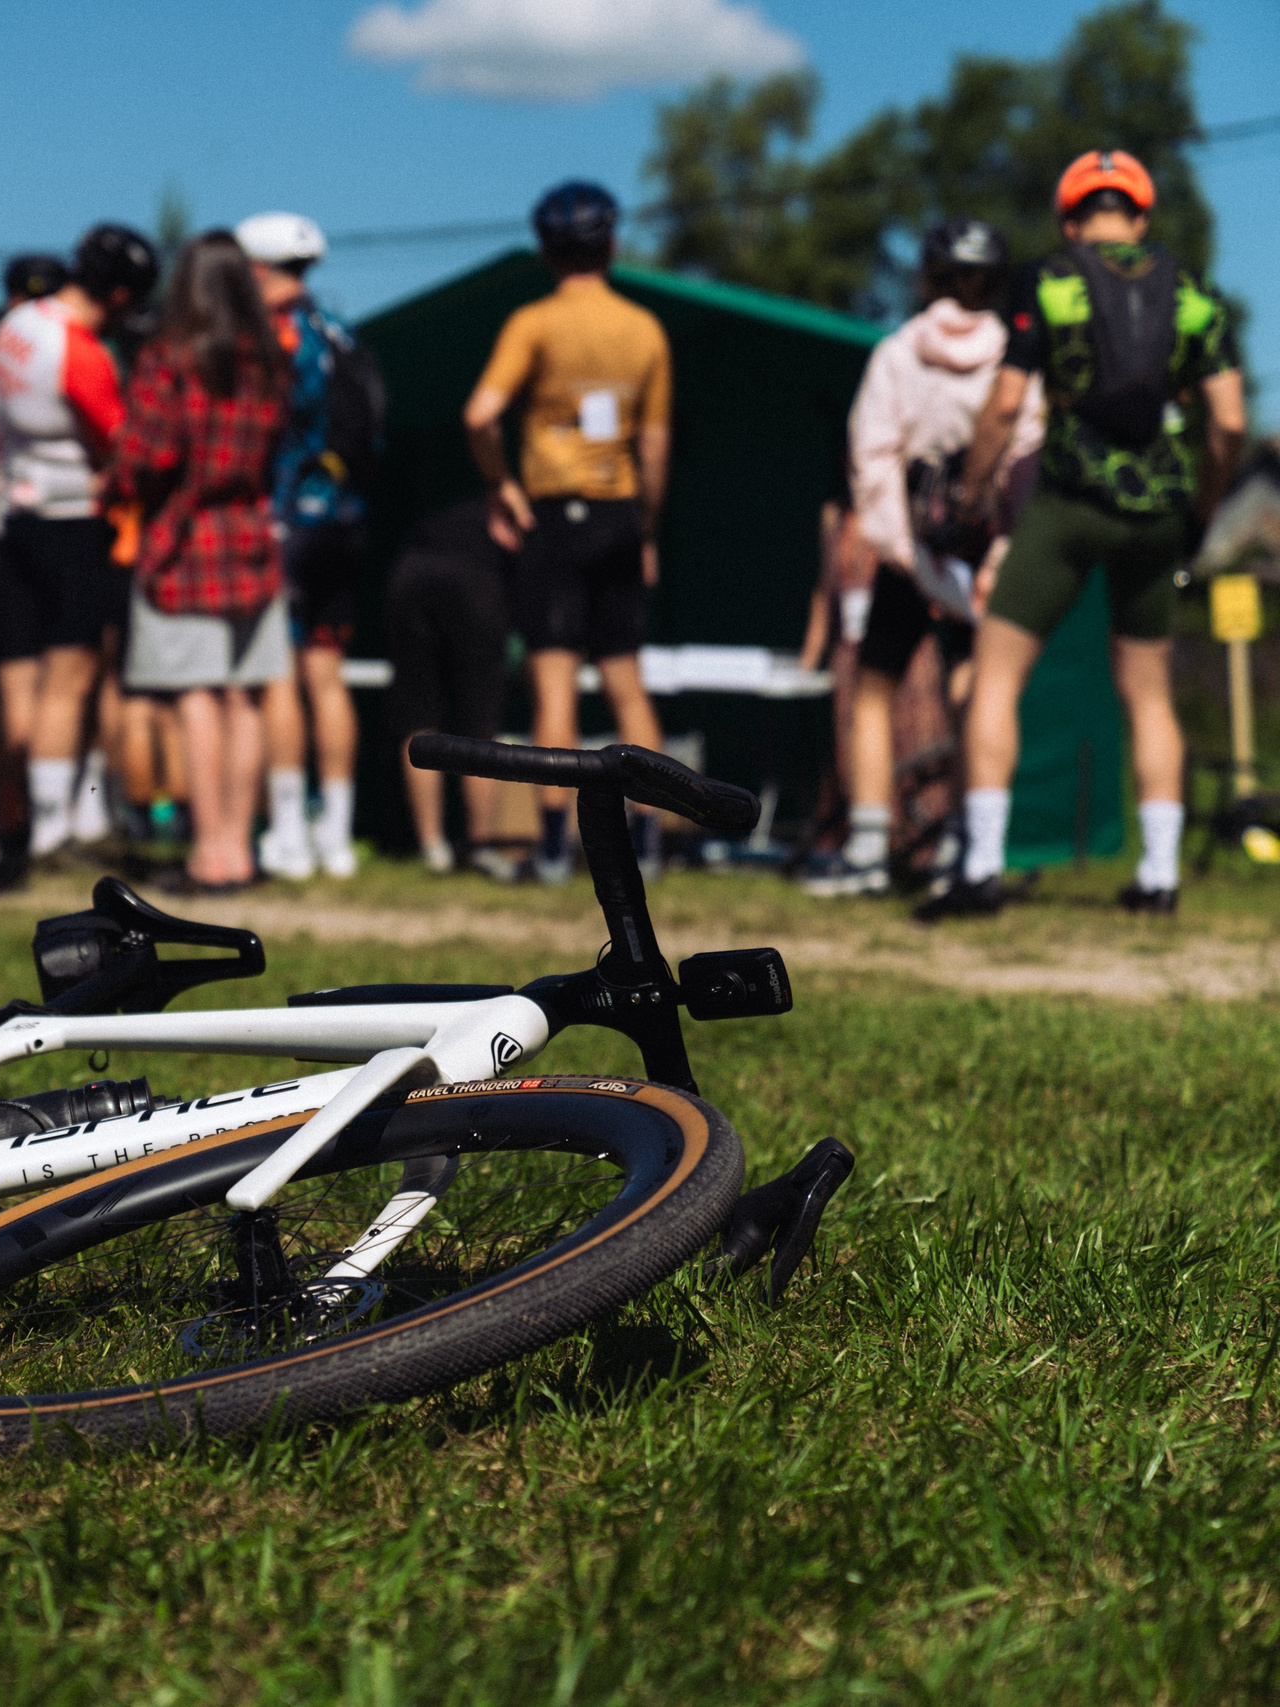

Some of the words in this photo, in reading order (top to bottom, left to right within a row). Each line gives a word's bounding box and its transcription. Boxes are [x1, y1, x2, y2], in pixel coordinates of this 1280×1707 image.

[766, 963, 782, 1004] Magene
[406, 1086, 449, 1100] RAVEL
[452, 1080, 521, 1094] THUNDERO
[22, 1163, 55, 1184] IS
